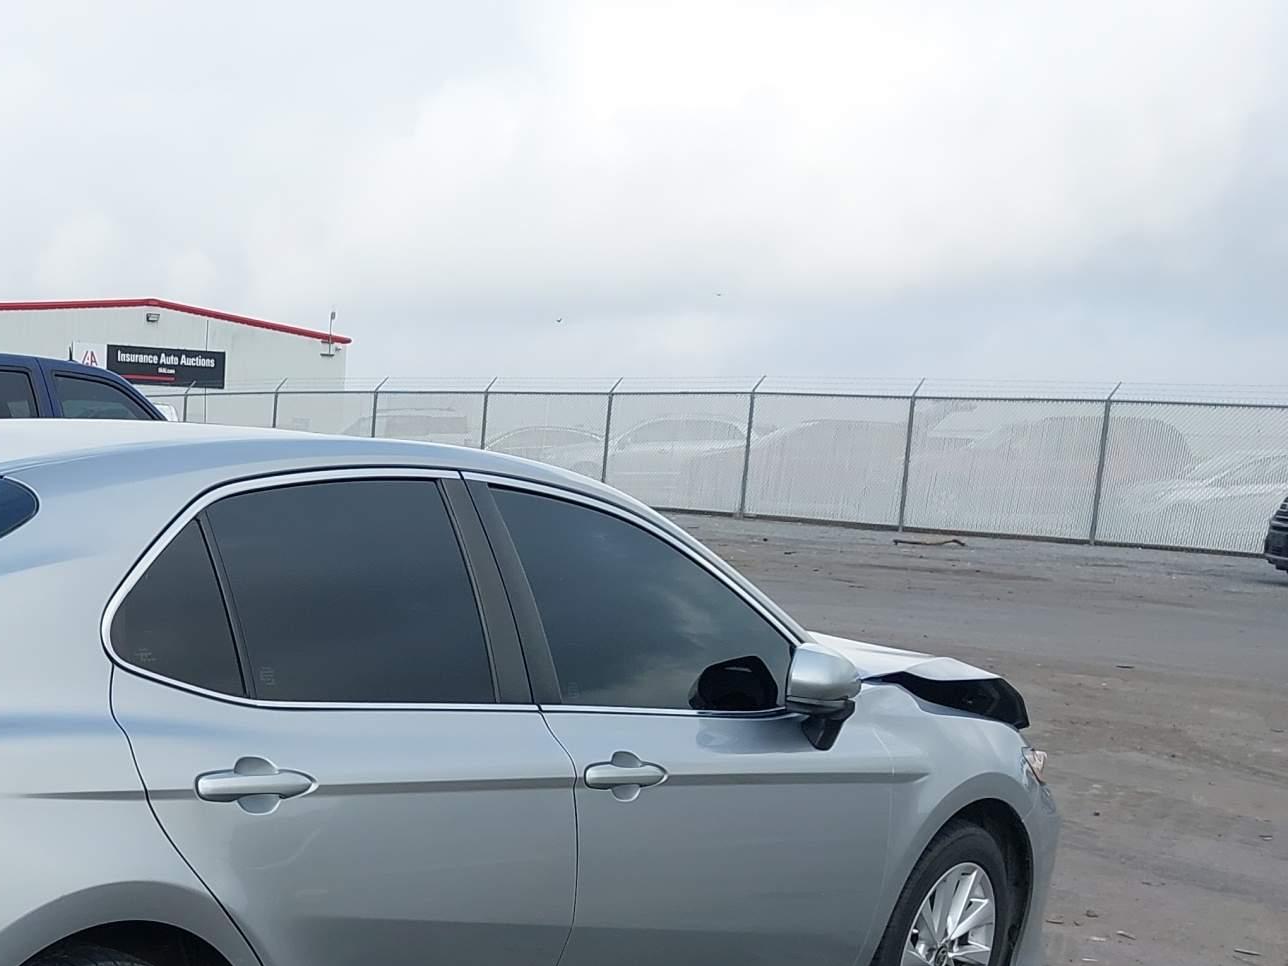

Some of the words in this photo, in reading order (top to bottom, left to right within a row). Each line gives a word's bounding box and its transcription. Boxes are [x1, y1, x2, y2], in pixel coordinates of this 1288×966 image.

[117, 349, 159, 364] Insurance
[159, 352, 179, 365] Auto
[180, 354, 215, 368] Auctions
